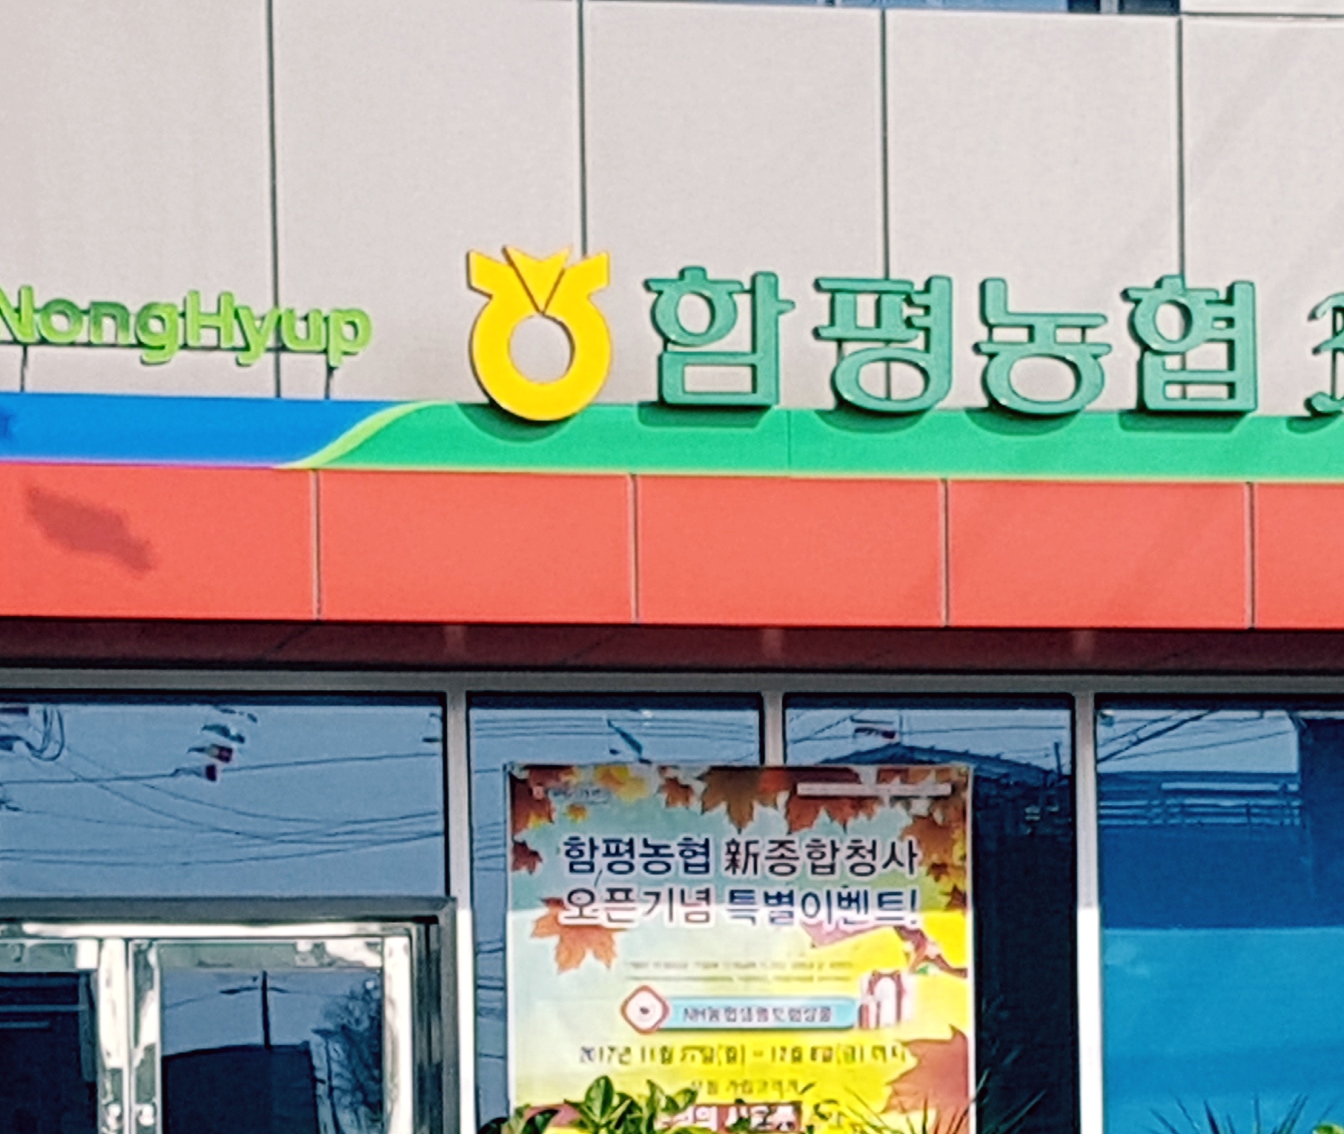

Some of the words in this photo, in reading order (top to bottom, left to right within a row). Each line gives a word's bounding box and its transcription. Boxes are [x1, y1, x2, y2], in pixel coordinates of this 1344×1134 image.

[643, 265, 1257, 414] 함평농협
[562, 836, 712, 876] 함평농협
[724, 838, 920, 877] 新종합청사
[563, 887, 712, 924] 오픈기념
[726, 887, 920, 926] 특별이벤트!
